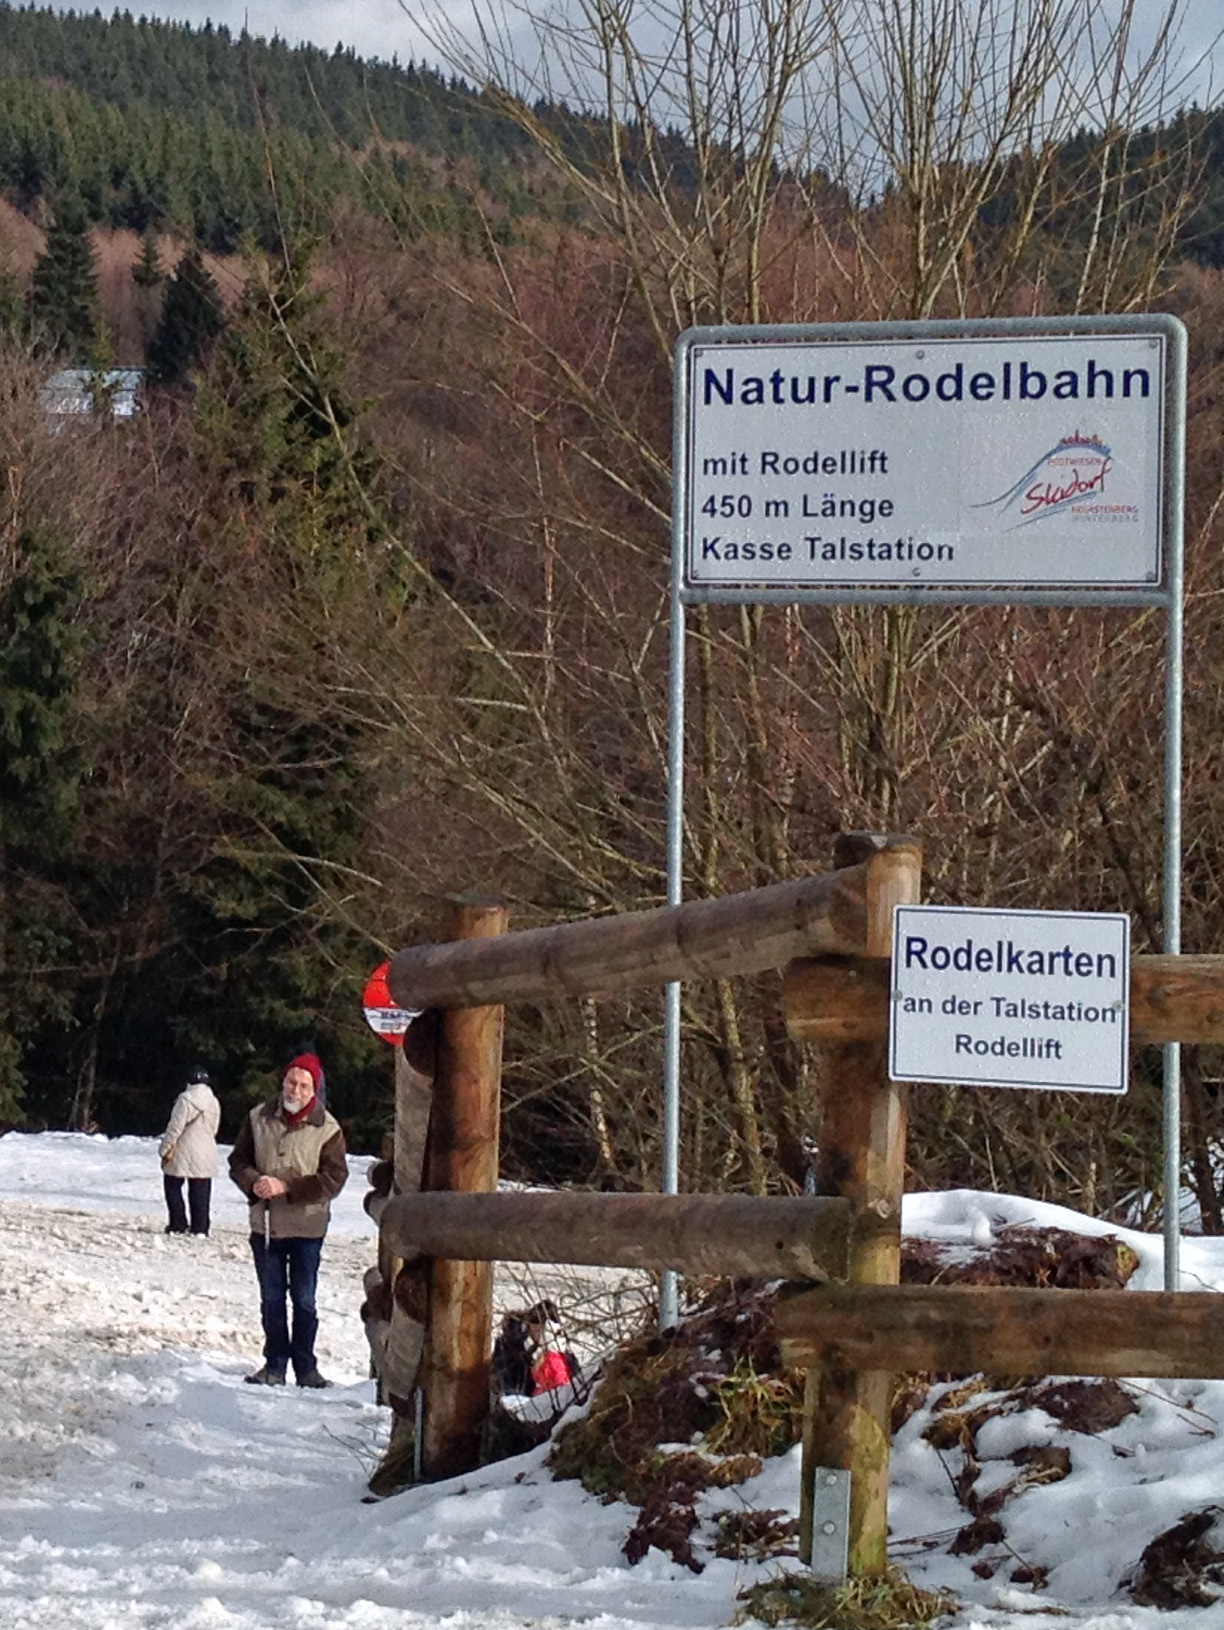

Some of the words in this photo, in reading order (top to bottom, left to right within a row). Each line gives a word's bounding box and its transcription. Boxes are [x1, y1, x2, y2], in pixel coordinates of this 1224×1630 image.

[703, 360, 1150, 405] Natur-Rodelbahn
[702, 452, 748, 475] mit
[761, 449, 888, 475] Rodellift
[701, 494, 753, 518] 450
[764, 499, 789, 518] m
[802, 493, 894, 524] Länge
[702, 536, 792, 561] Kasse
[803, 536, 954, 562] Talstation
[905, 936, 1116, 978] Rodelkarten
[903, 997, 933, 1014] an
[941, 994, 983, 1016] der
[990, 996, 1116, 1023] Talstation
[955, 1033, 1062, 1060] Rodellift
